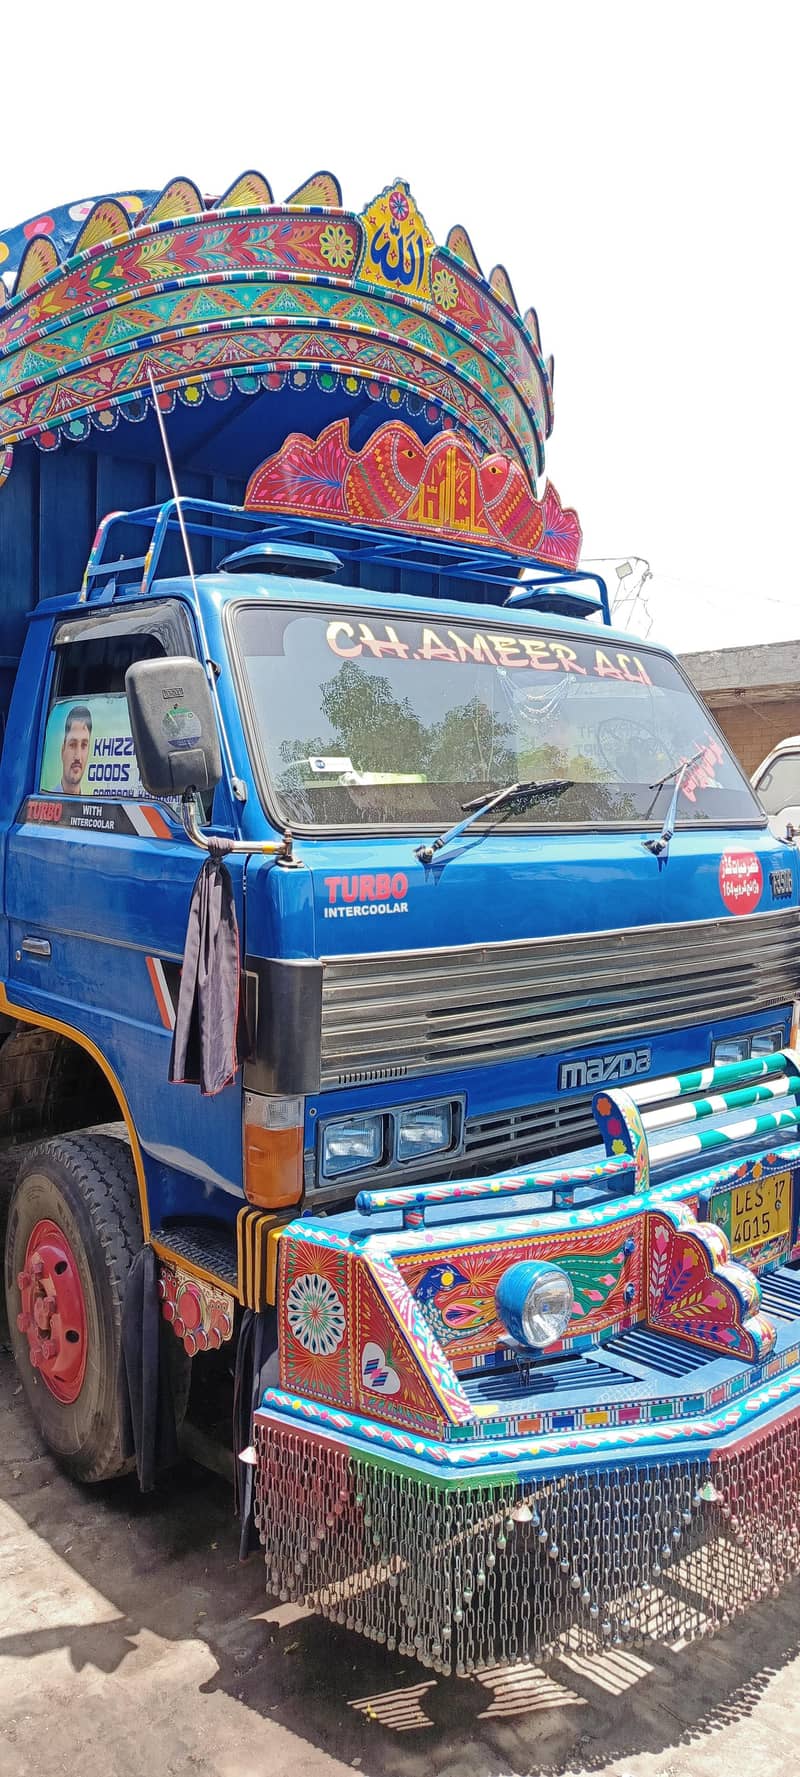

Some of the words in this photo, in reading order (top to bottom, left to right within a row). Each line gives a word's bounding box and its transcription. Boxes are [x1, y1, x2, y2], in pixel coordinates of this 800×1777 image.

[93, 736, 137, 757] KHIZZ
[87, 763, 131, 782] GOODS
[27, 801, 63, 822] TURBO
[82, 804, 103, 817] WITH
[70, 818, 115, 830] INTERCOOLAR
[324, 872, 408, 904] TURBO
[324, 902, 409, 918] INTERCOOLAR
[736, 1187, 763, 1216] LES
[775, 1180, 785, 1199] 17
[734, 1211, 770, 1244] 4015
